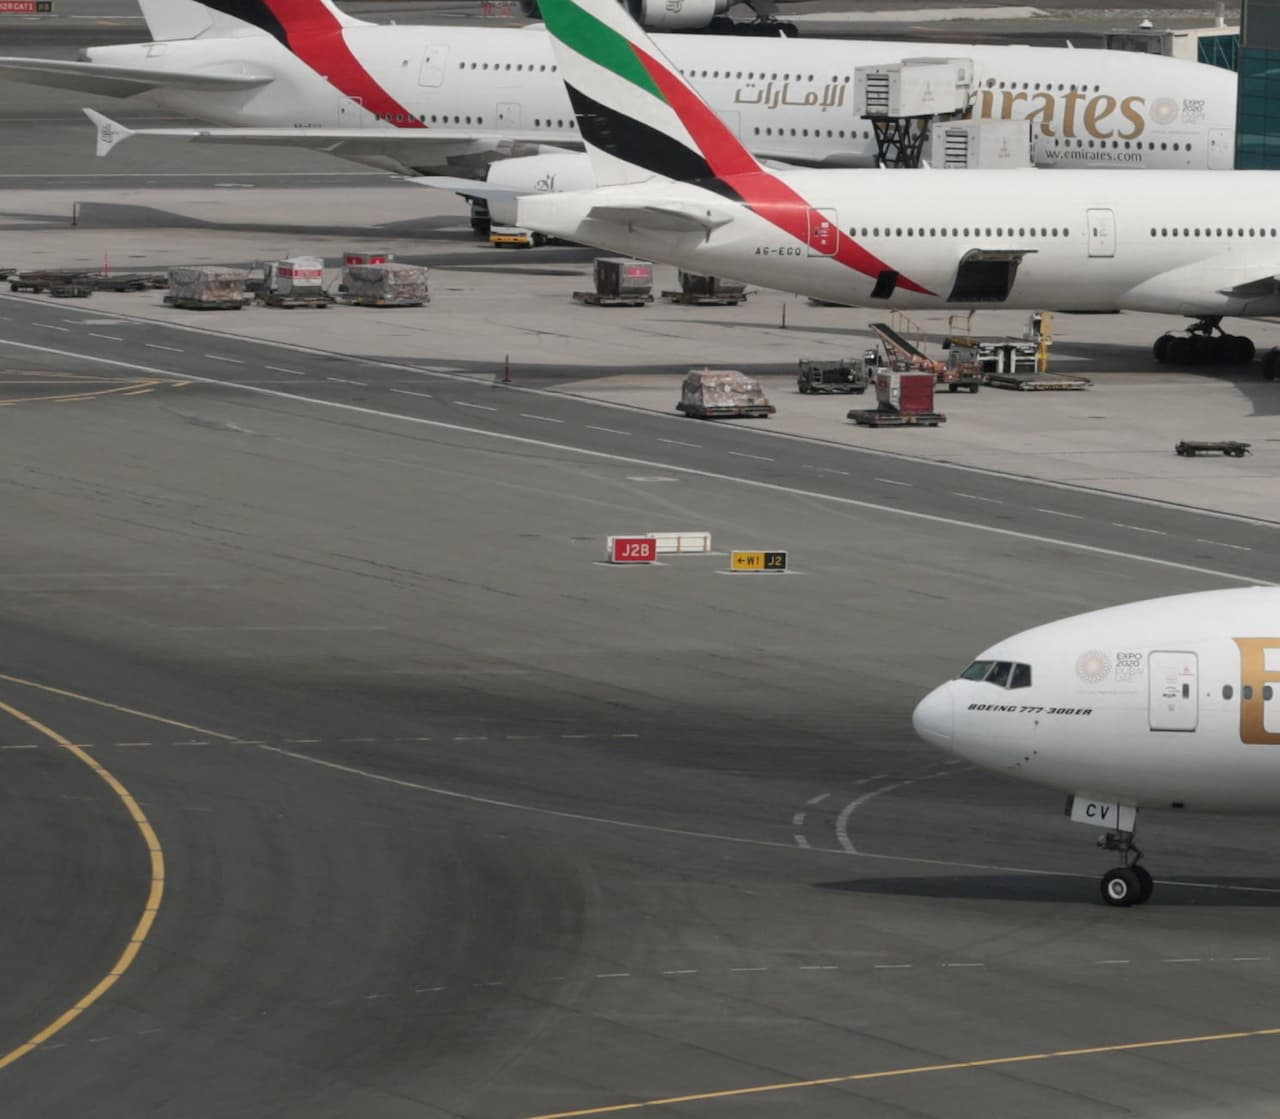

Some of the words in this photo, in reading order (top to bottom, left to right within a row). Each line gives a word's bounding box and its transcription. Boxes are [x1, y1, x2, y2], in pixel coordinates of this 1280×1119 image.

[621, 543, 650, 557] J2B
[768, 556, 783, 566] J2
[1116, 652, 1143, 660] EXPO
[967, 703, 1018, 712] BOEING
[1086, 803, 1110, 820] CV
